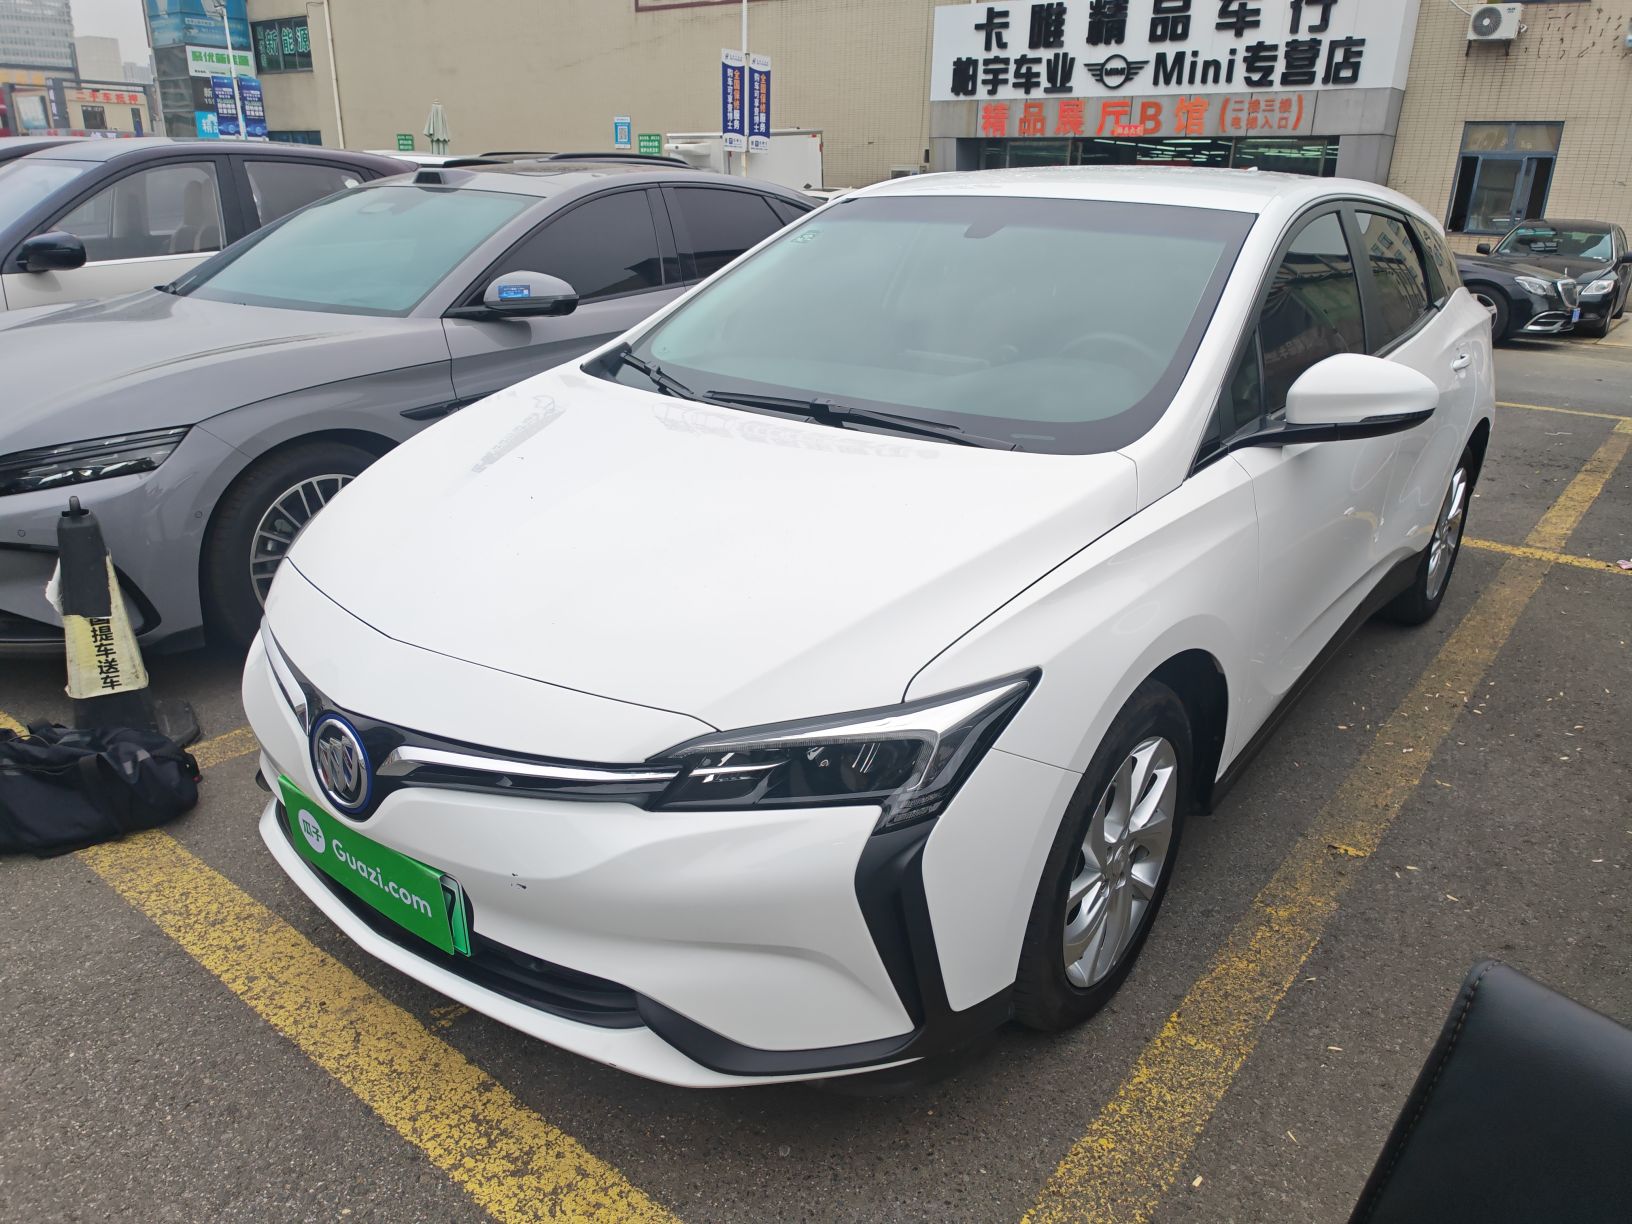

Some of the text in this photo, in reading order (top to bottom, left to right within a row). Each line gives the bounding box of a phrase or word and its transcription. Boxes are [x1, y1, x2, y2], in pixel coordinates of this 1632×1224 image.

[265, 27, 310, 55] 新能源
[951, 52, 1076, 96] 柏宇车业
[1104, 66, 1127, 76] MINI
[302, 819, 322, 842] 瓜子
[332, 839, 433, 918] Guazi.com
